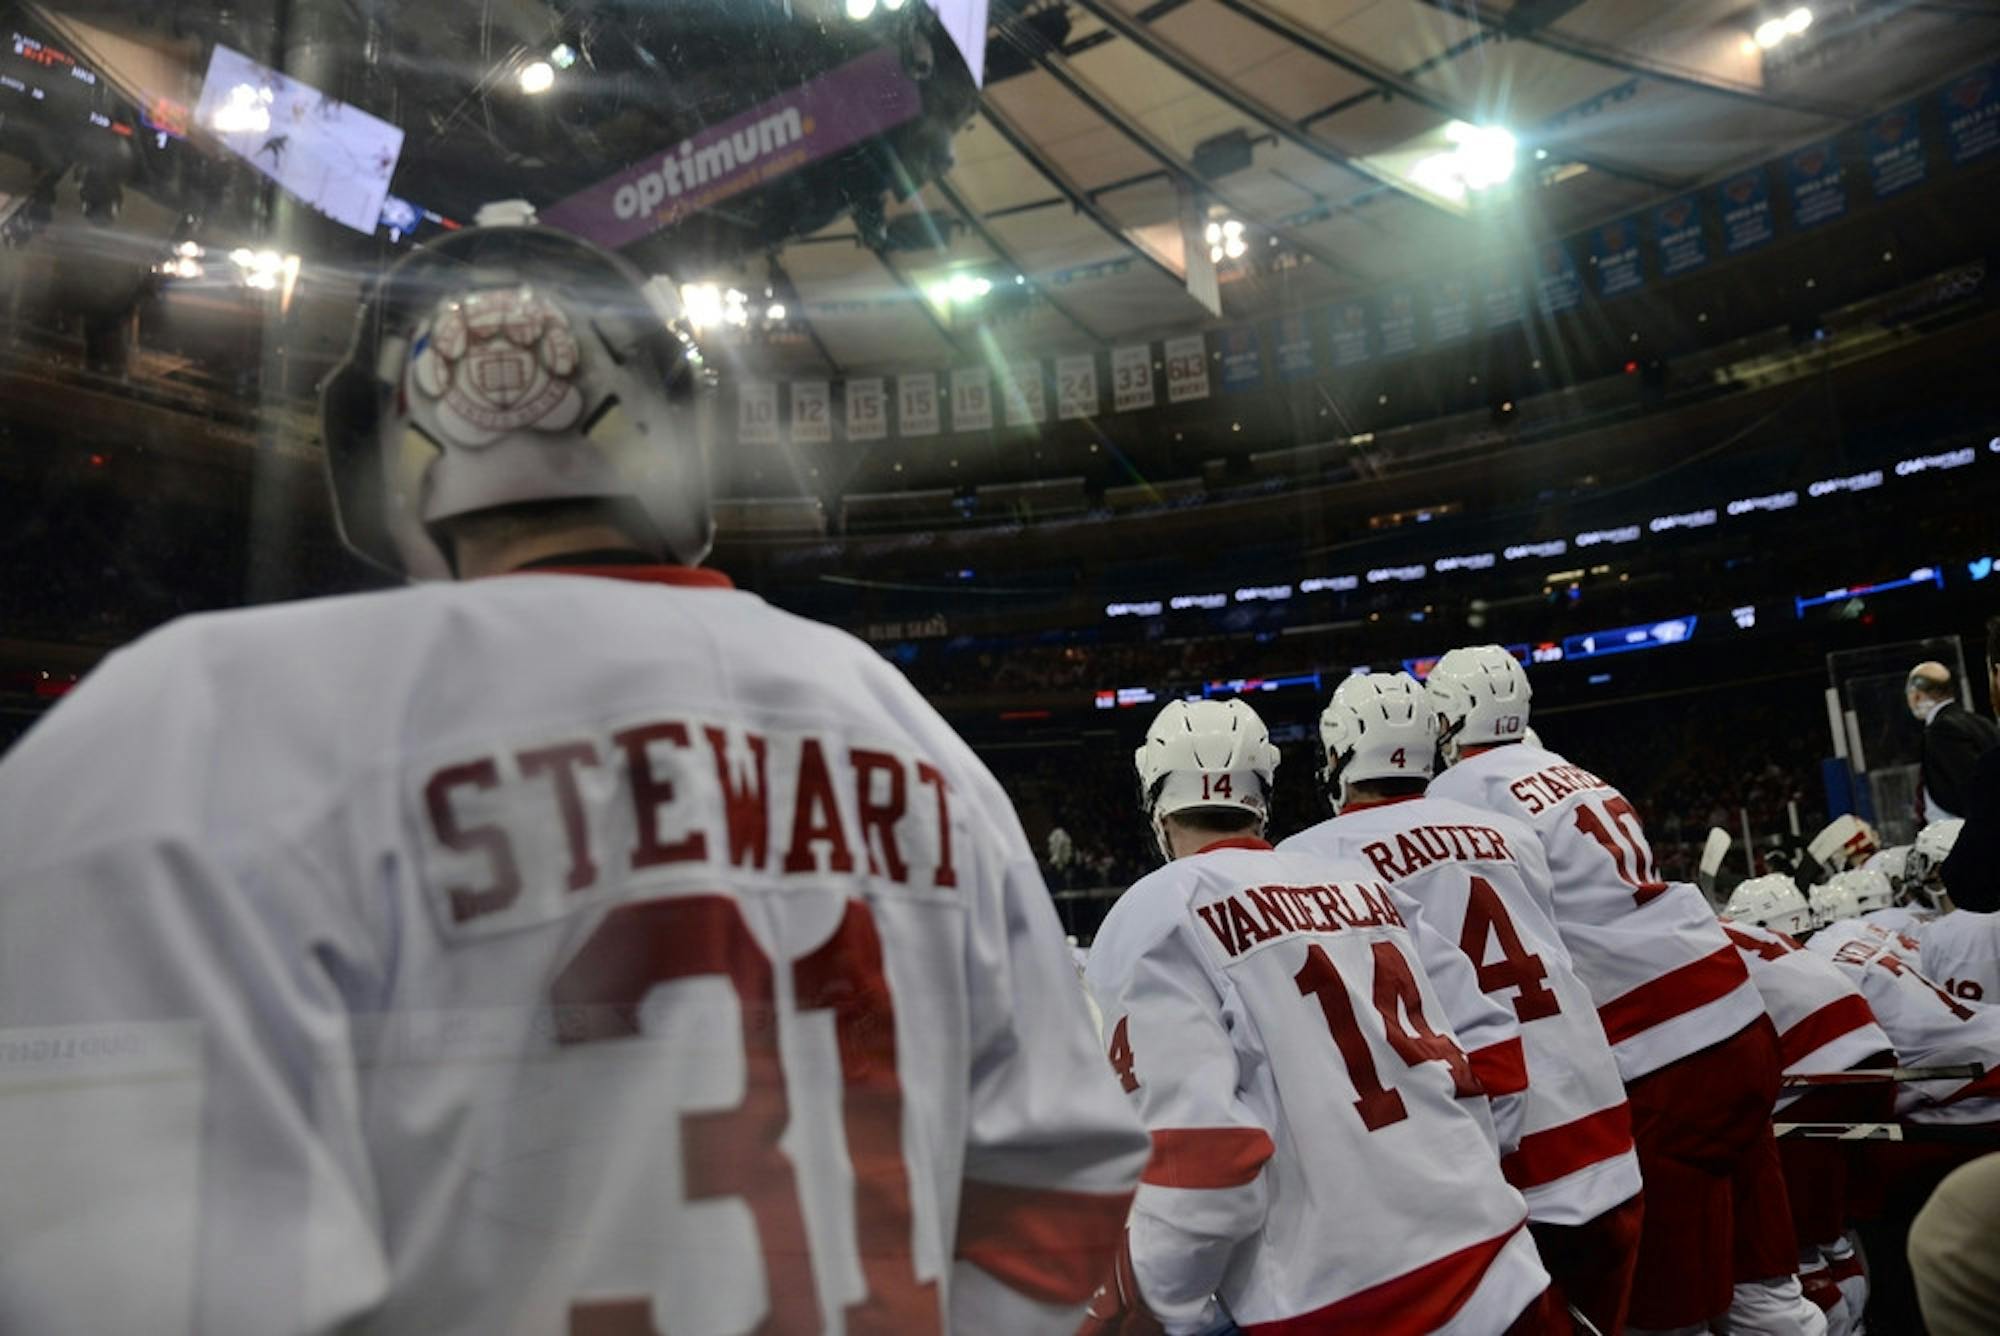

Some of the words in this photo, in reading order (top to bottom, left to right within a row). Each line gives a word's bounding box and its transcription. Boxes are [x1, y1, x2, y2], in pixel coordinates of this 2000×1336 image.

[1117, 364, 1149, 390] 33
[1168, 354, 1205, 382] 613
[1060, 372, 1093, 399] 24
[796, 400, 826, 423] 12
[853, 395, 880, 420] 15
[1389, 747, 1407, 769] 4
[1201, 773, 1233, 801] 14
[424, 720, 958, 925] STEWART
[1360, 825, 1516, 884] RAUTER
[1459, 875, 1562, 1022] 4
[1294, 940, 1489, 1132] 14
[549, 892, 946, 1336] 31
